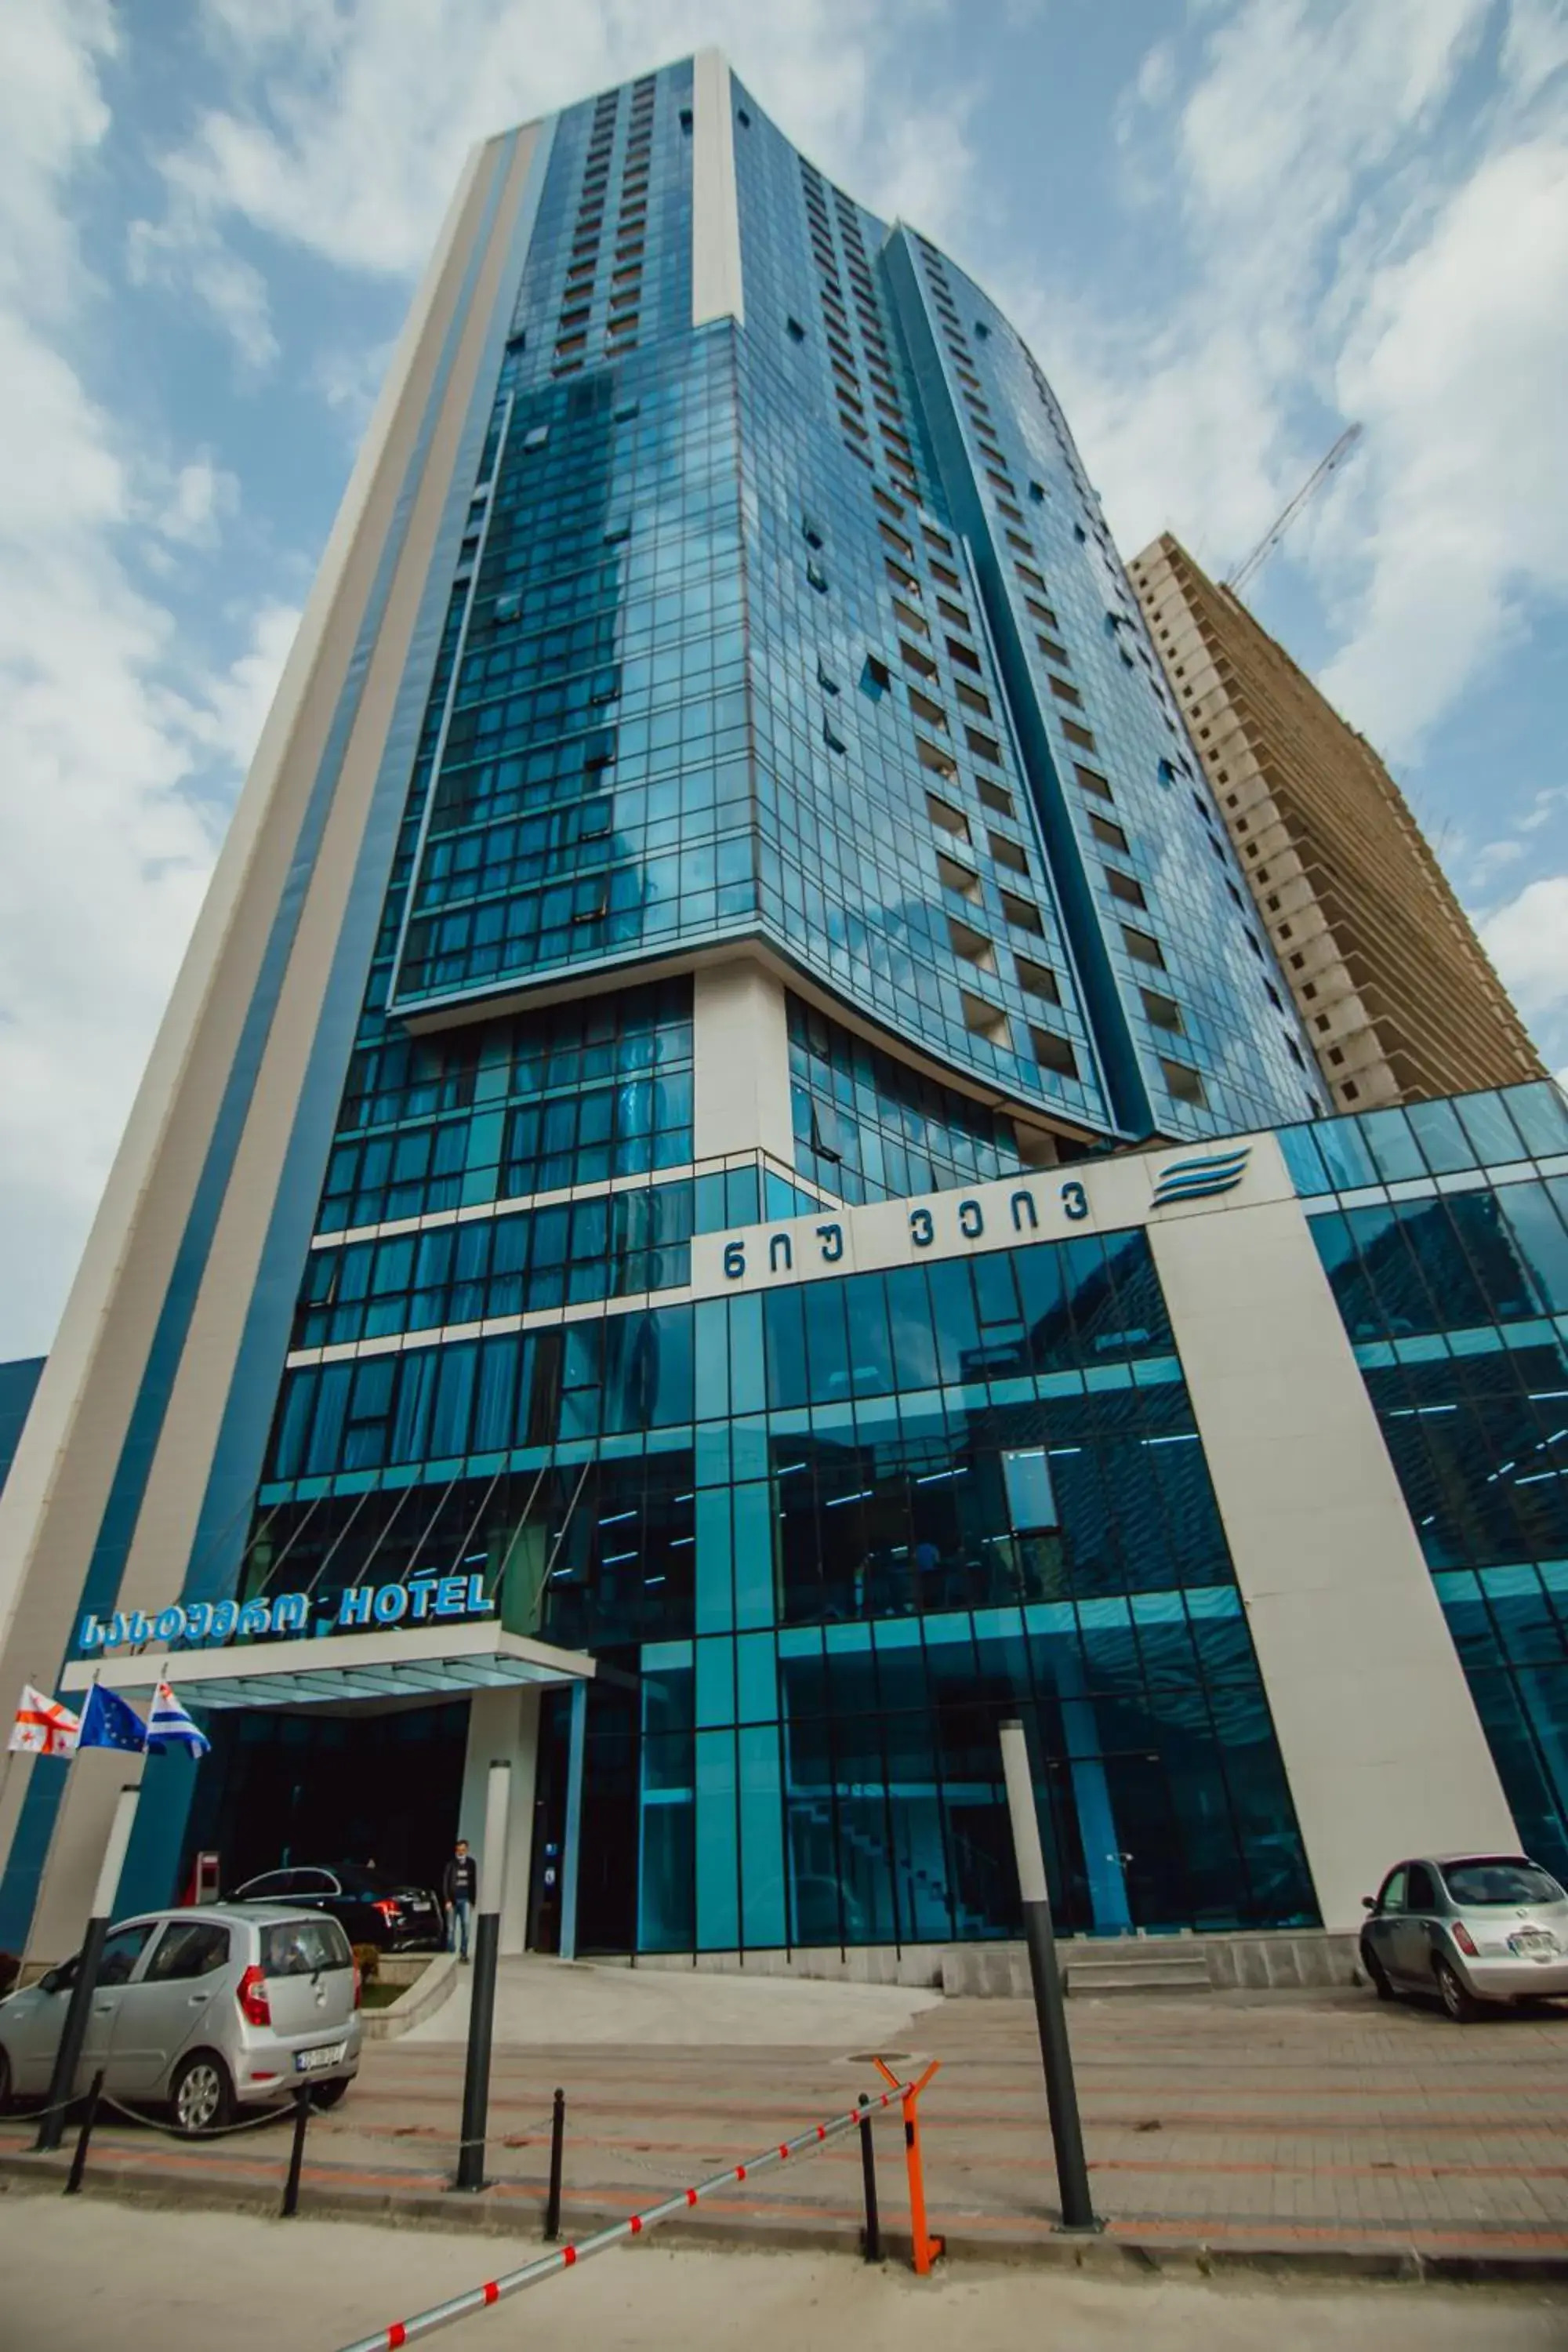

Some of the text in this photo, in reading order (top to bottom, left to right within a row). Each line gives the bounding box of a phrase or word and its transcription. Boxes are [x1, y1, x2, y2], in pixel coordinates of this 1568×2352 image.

[724, 1181, 1089, 1279] ნიუ ვეივ
[79, 1573, 495, 1650] სასტუმრო HOTEL
